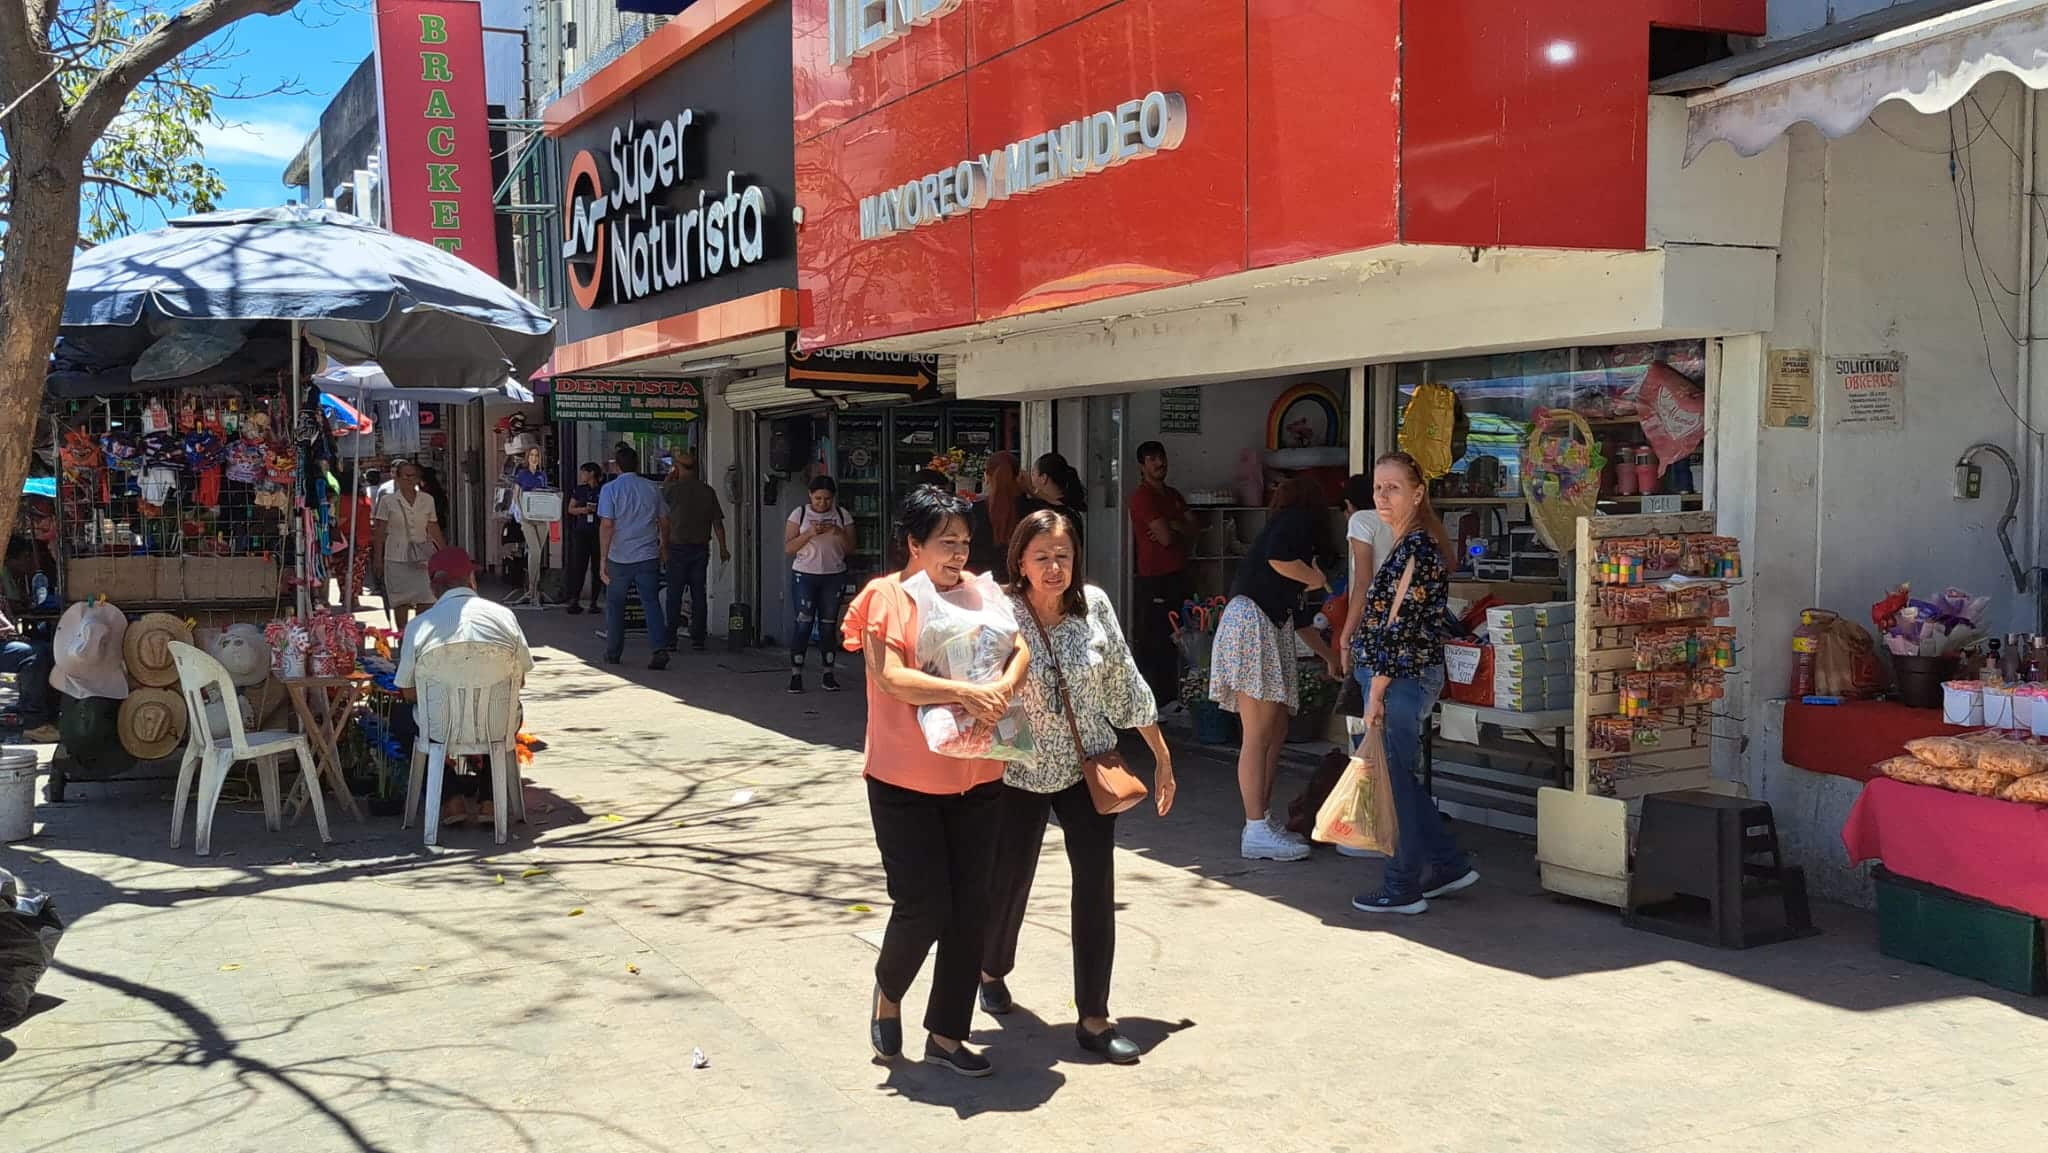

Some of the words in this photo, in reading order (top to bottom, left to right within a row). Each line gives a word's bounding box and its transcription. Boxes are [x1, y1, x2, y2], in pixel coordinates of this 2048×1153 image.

[610, 108, 692, 220] Súper
[860, 160, 980, 240] MAYOREO
[1005, 90, 1175, 194] MENUDEO
[611, 170, 764, 304] Naturista
[555, 379, 698, 396] DENTISTA
[1836, 359, 1900, 375] SOLICITAMOS
